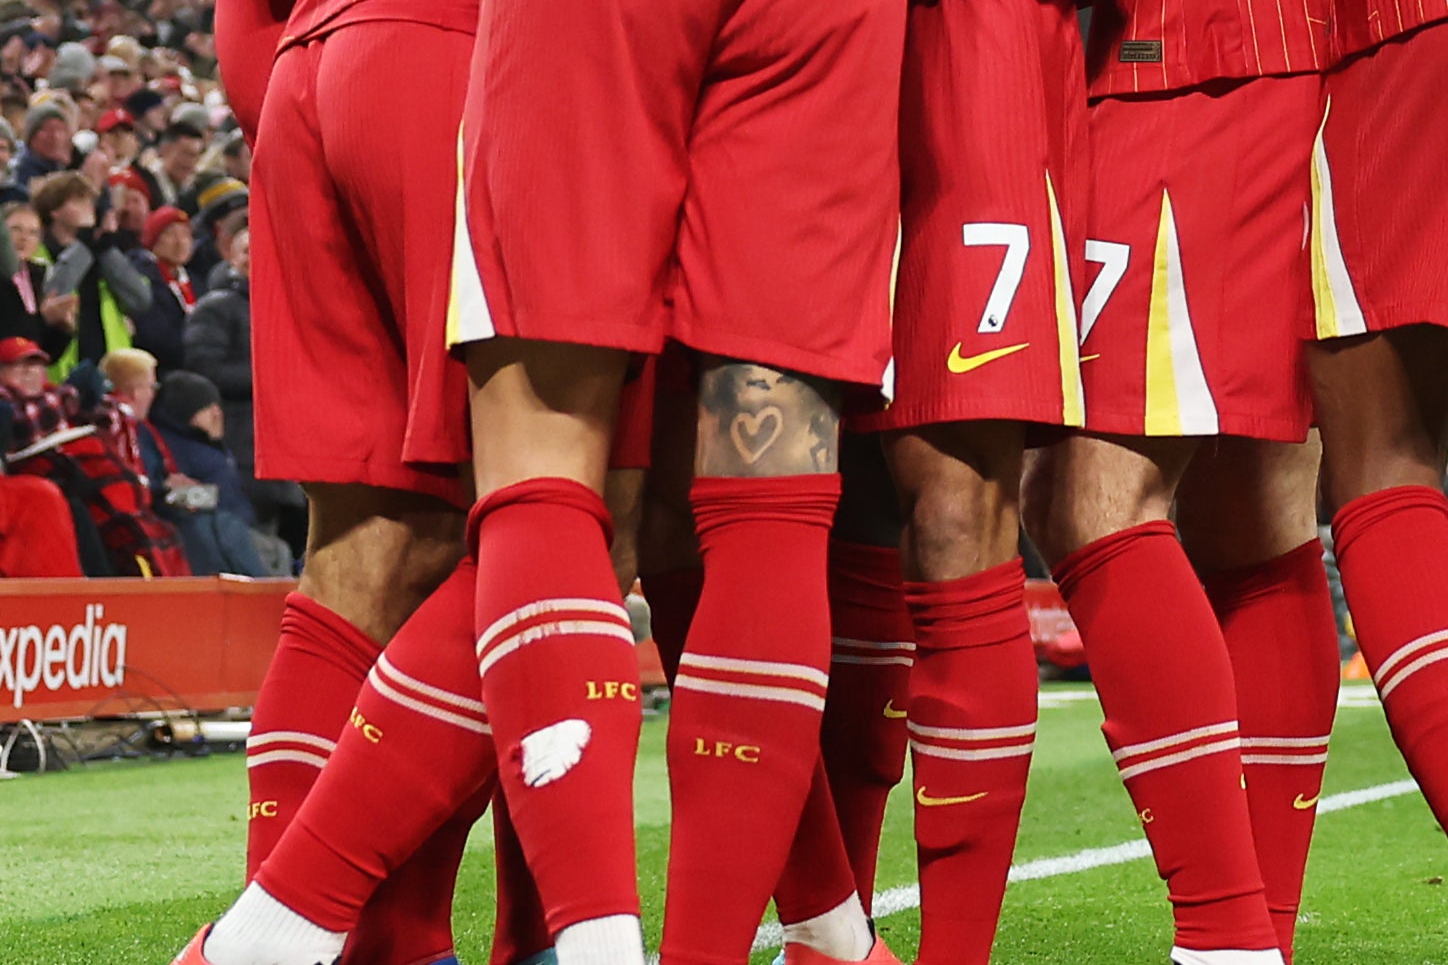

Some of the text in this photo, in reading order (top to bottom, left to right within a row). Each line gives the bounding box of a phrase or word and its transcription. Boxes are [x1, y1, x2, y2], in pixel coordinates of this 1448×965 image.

[962, 222, 1030, 334] 7
[1078, 239, 1131, 347] 7
[586, 681, 637, 701] LFC
[694, 738, 761, 763] LFC
